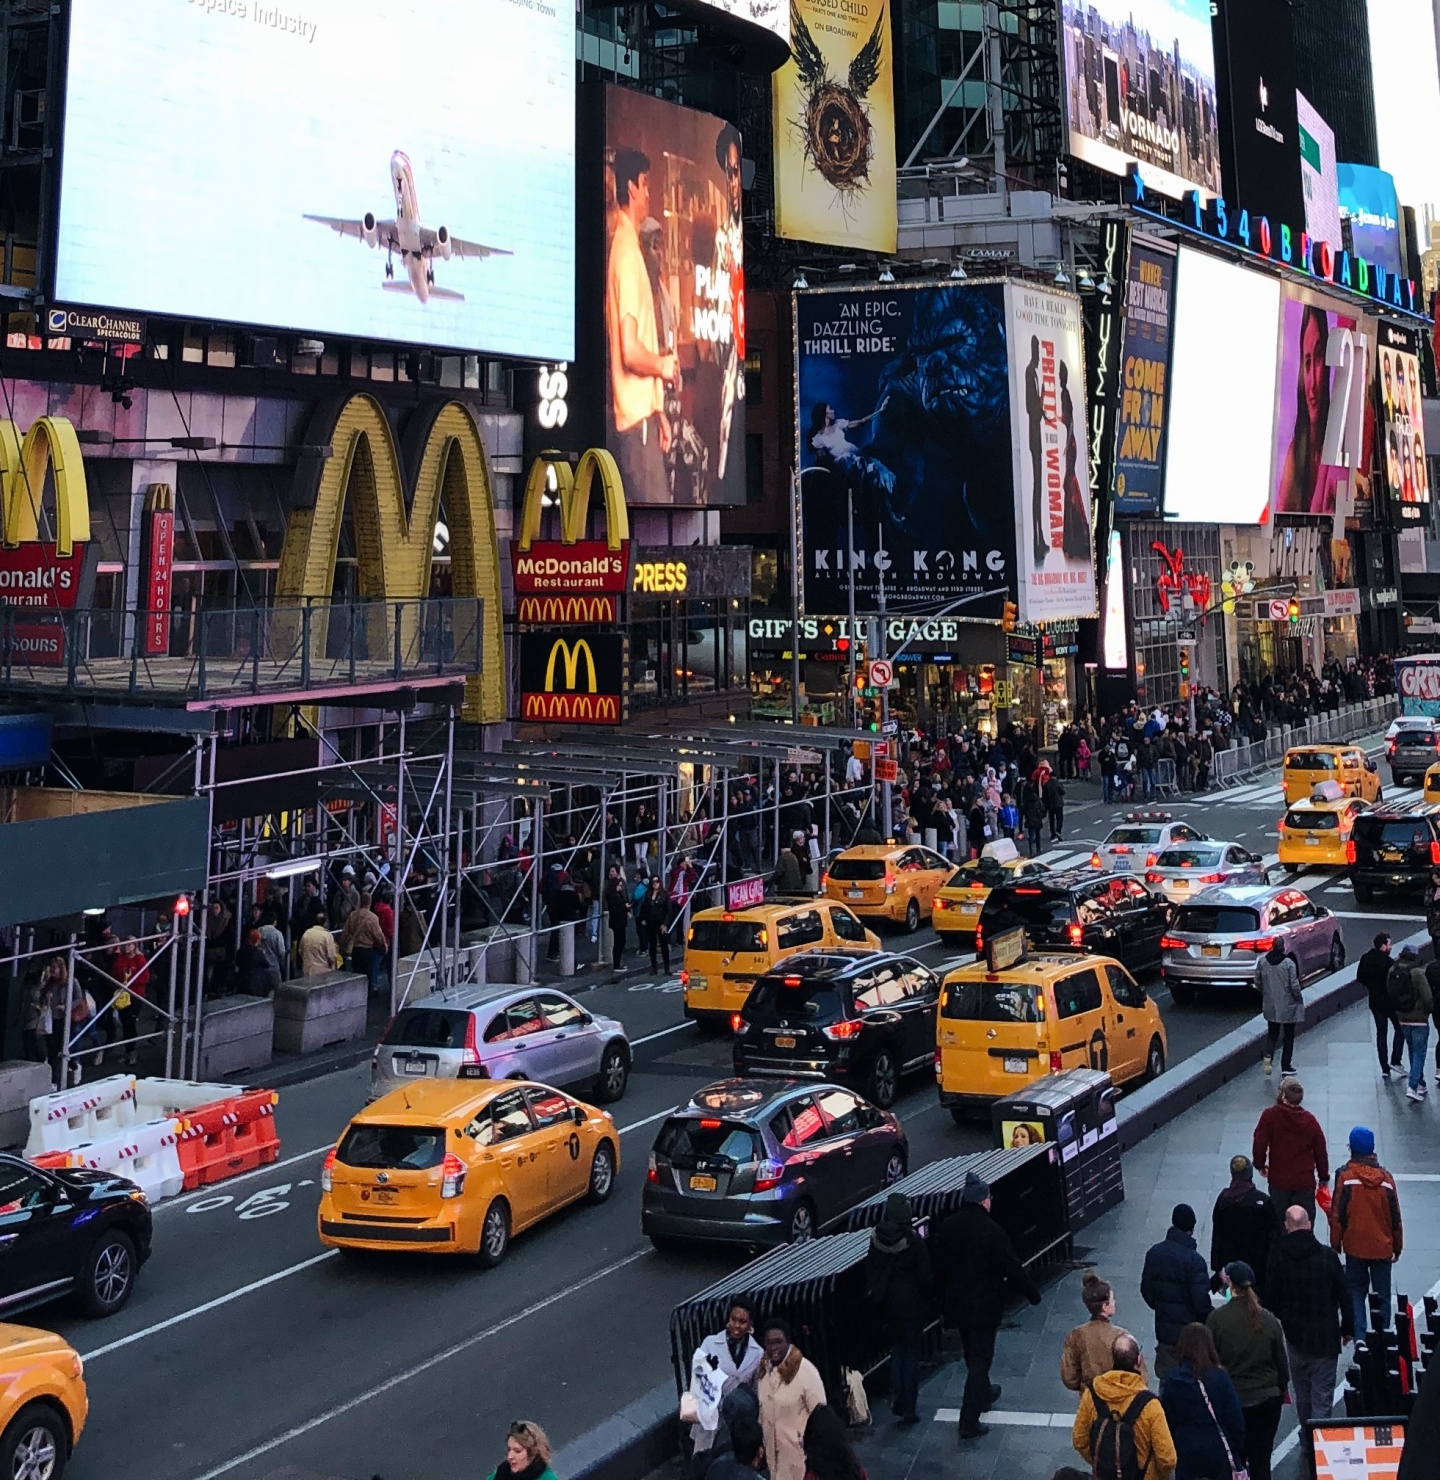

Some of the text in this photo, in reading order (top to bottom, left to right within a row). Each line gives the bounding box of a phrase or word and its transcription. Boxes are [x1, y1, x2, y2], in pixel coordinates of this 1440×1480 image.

[536, 2, 556, 17] TOWN
[841, 0, 868, 17] CHILD
[254, 1, 317, 43] Industry
[815, 21, 858, 39] ON BROADWAY
[1119, 106, 1180, 154] VORNADO
[1131, 137, 1172, 164] REALTY TRUST
[970, 249, 1011, 258] LAMAR
[1281, 223, 1417, 312] BROADWAY
[865, 301, 901, 317] EPIC,
[1023, 295, 1067, 315] HAVE A REALLY
[695, 306, 731, 345] NOW
[813, 319, 883, 337] DAZZLING
[1016, 309, 1076, 333] GOOD TIME TONIGHT
[97, 329, 140, 340] SPECTACOLOR
[804, 338, 851, 355] THRILL
[1041, 339, 1058, 430] PRETTY
[1125, 355, 1165, 394] COME
[1119, 424, 1161, 462] AWAY
[1045, 447, 1063, 549] WOMAN
[517, 556, 622, 575] McDonald's
[815, 549, 1005, 572] KING KONG
[155, 520, 167, 646] OPEN 24 HOURS
[534, 577, 604, 588] Restaurant
[914, 572, 1005, 581] BROADWAY
[749, 619, 957, 642] GIFS LUGAGE
[814, 651, 846, 661] Canon
[997, 682, 1005, 704] ATM
